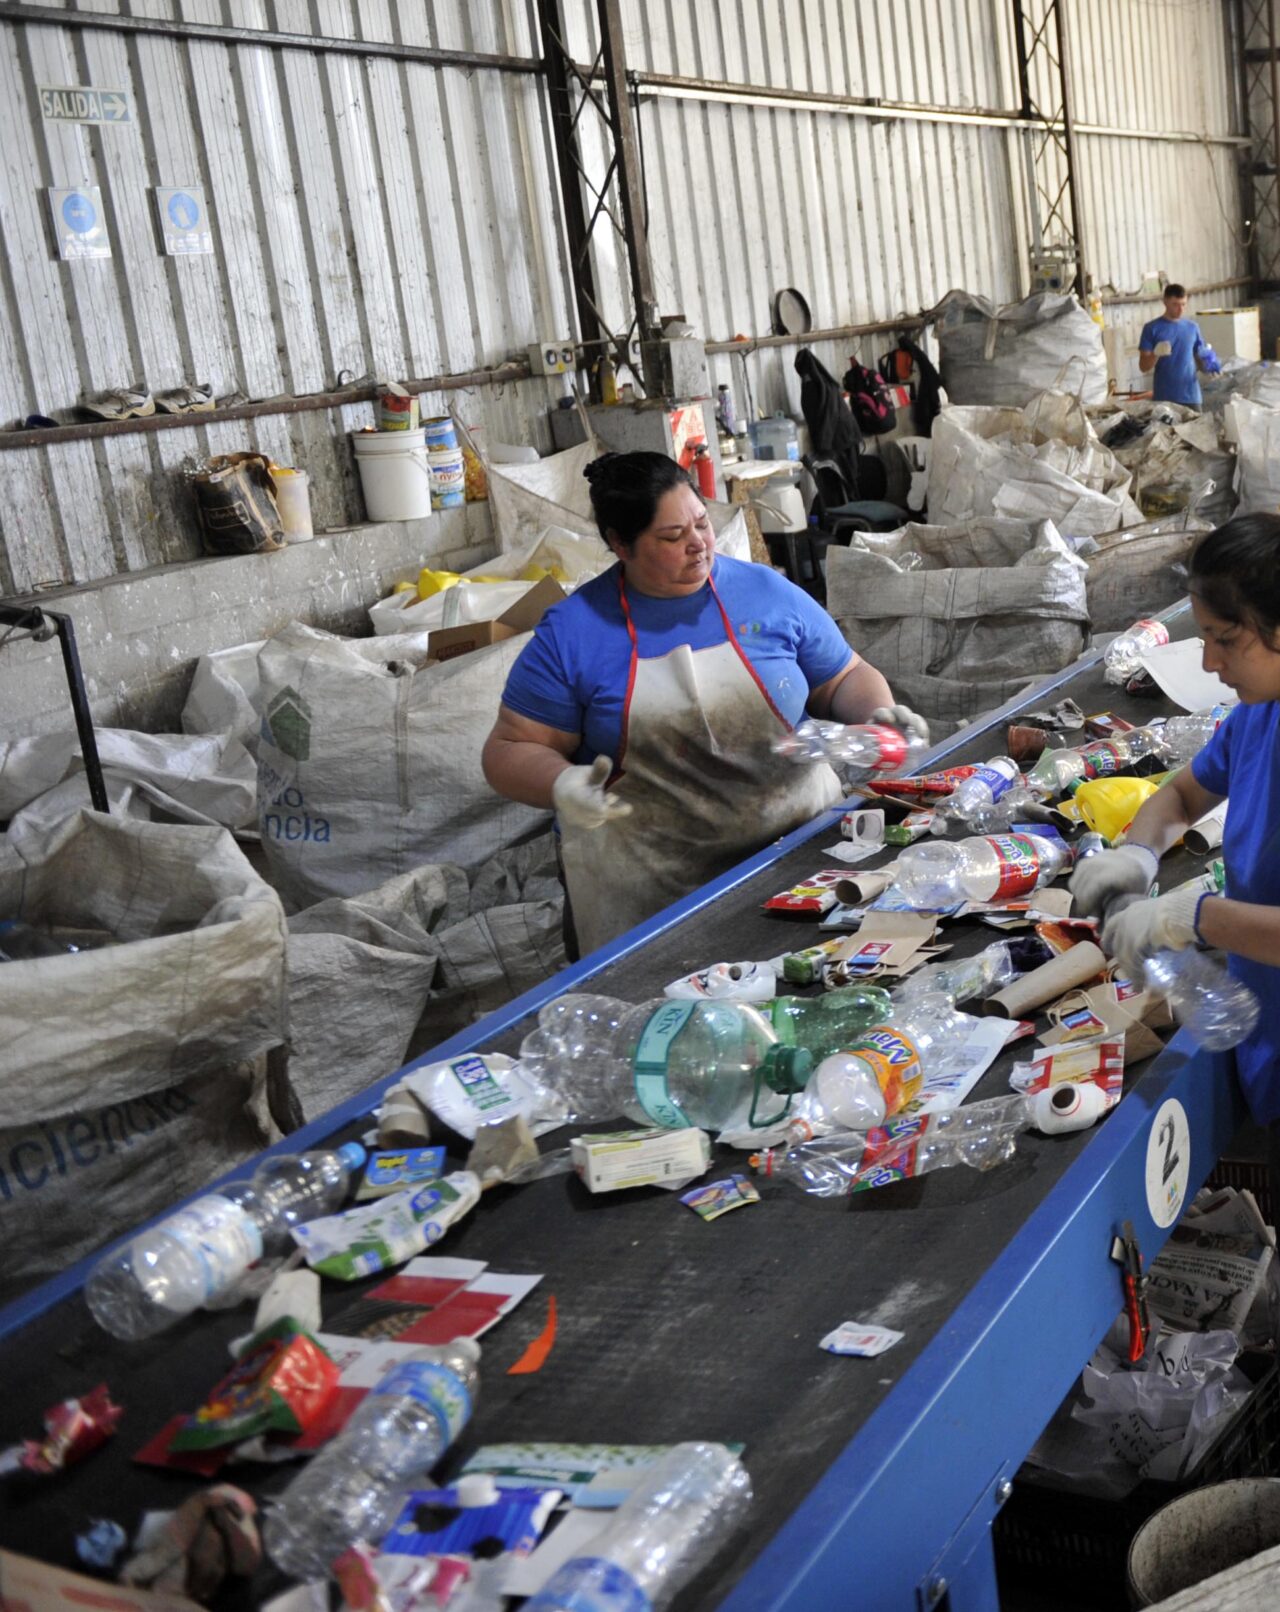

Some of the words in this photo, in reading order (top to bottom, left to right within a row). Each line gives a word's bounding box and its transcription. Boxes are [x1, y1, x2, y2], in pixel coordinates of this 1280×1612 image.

[42, 91, 101, 119] SALIDA
[1158, 1113, 1180, 1186] 2
[1147, 1273, 1200, 1298] NACI
